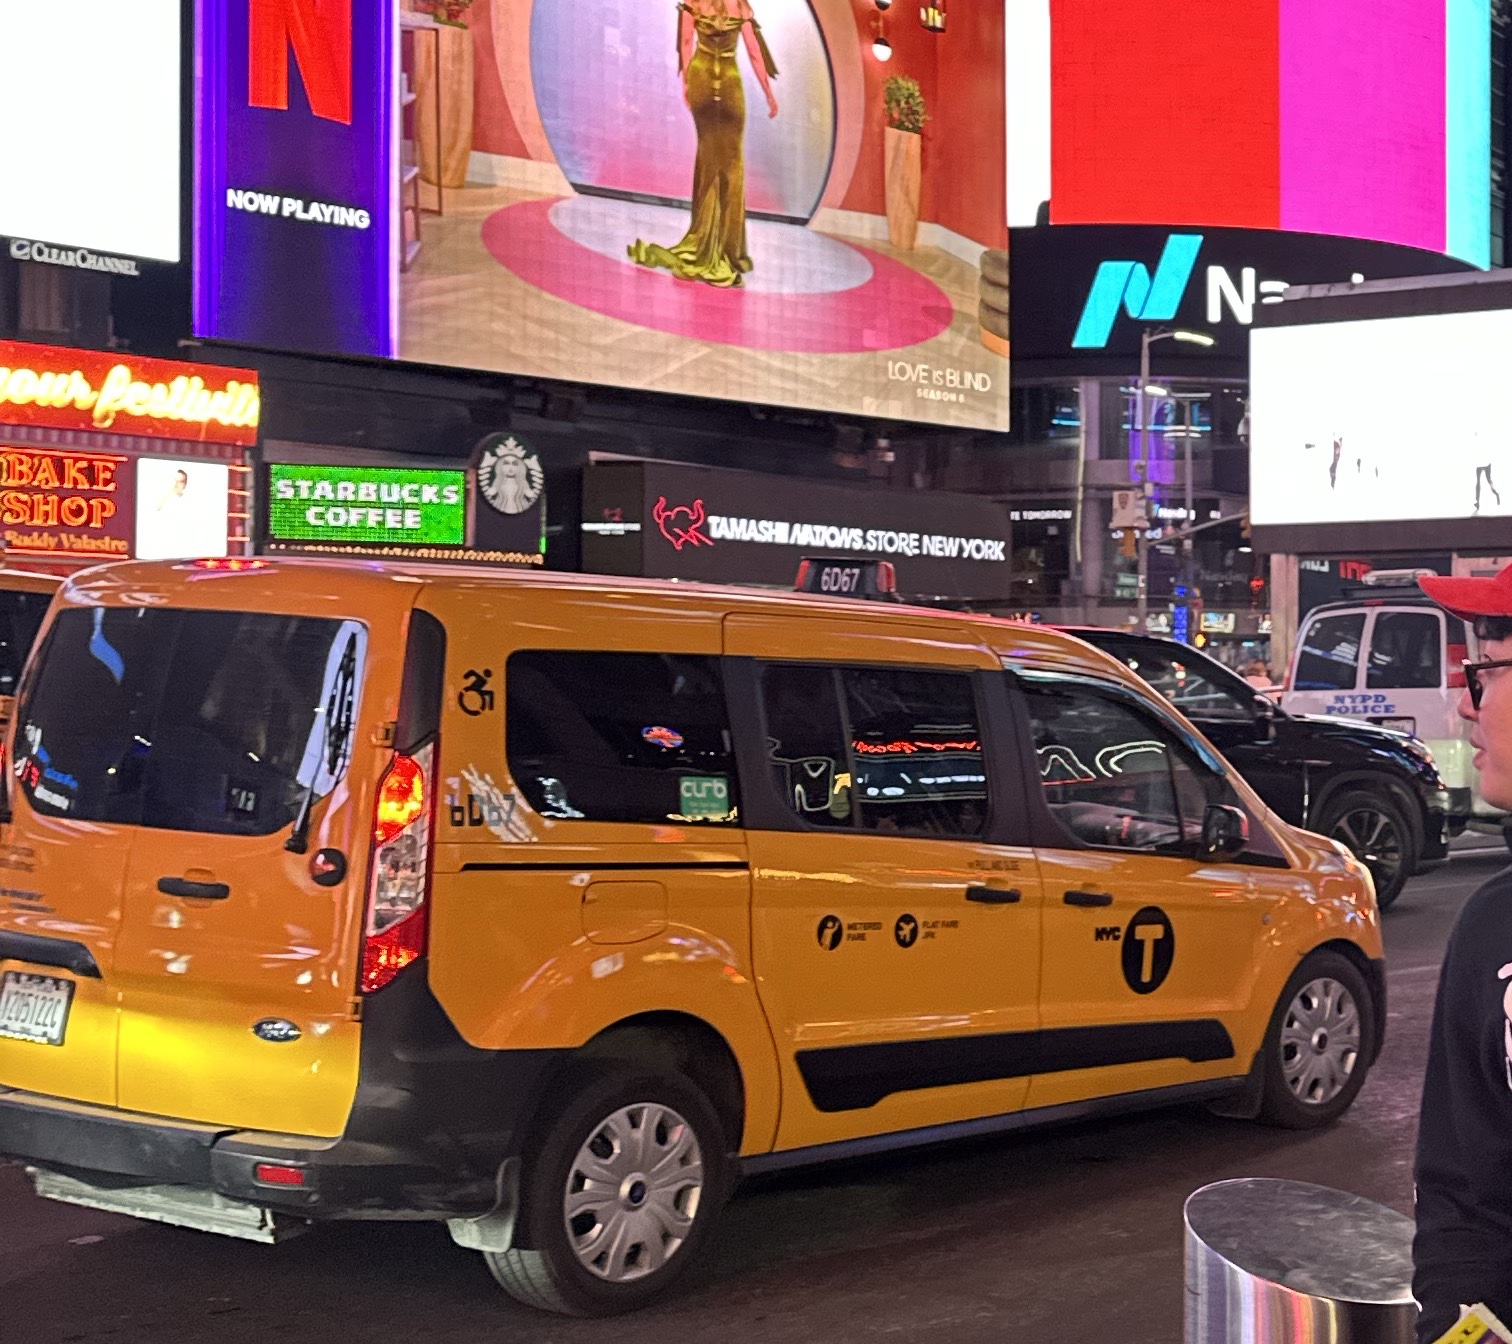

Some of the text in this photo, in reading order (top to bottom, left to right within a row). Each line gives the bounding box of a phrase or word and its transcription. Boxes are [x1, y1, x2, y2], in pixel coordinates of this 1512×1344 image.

[226, 189, 370, 229] NOW PLAYING
[887, 360, 929, 385] LOVE
[945, 368, 992, 392] BLIND
[916, 388, 957, 402] SEASON
[2, 454, 118, 492] BAKE
[274, 479, 460, 506] STARBUCKS
[2, 491, 117, 529] SHOP
[305, 507, 422, 530] COFFEE
[922, 534, 960, 559] NEW
[961, 538, 1006, 562] YORK
[820, 567, 861, 593] 6D67
[1325, 704, 1396, 715] POLICE
[1334, 694, 1386, 704] NYPD
[1095, 924, 1164, 983] NYC T
